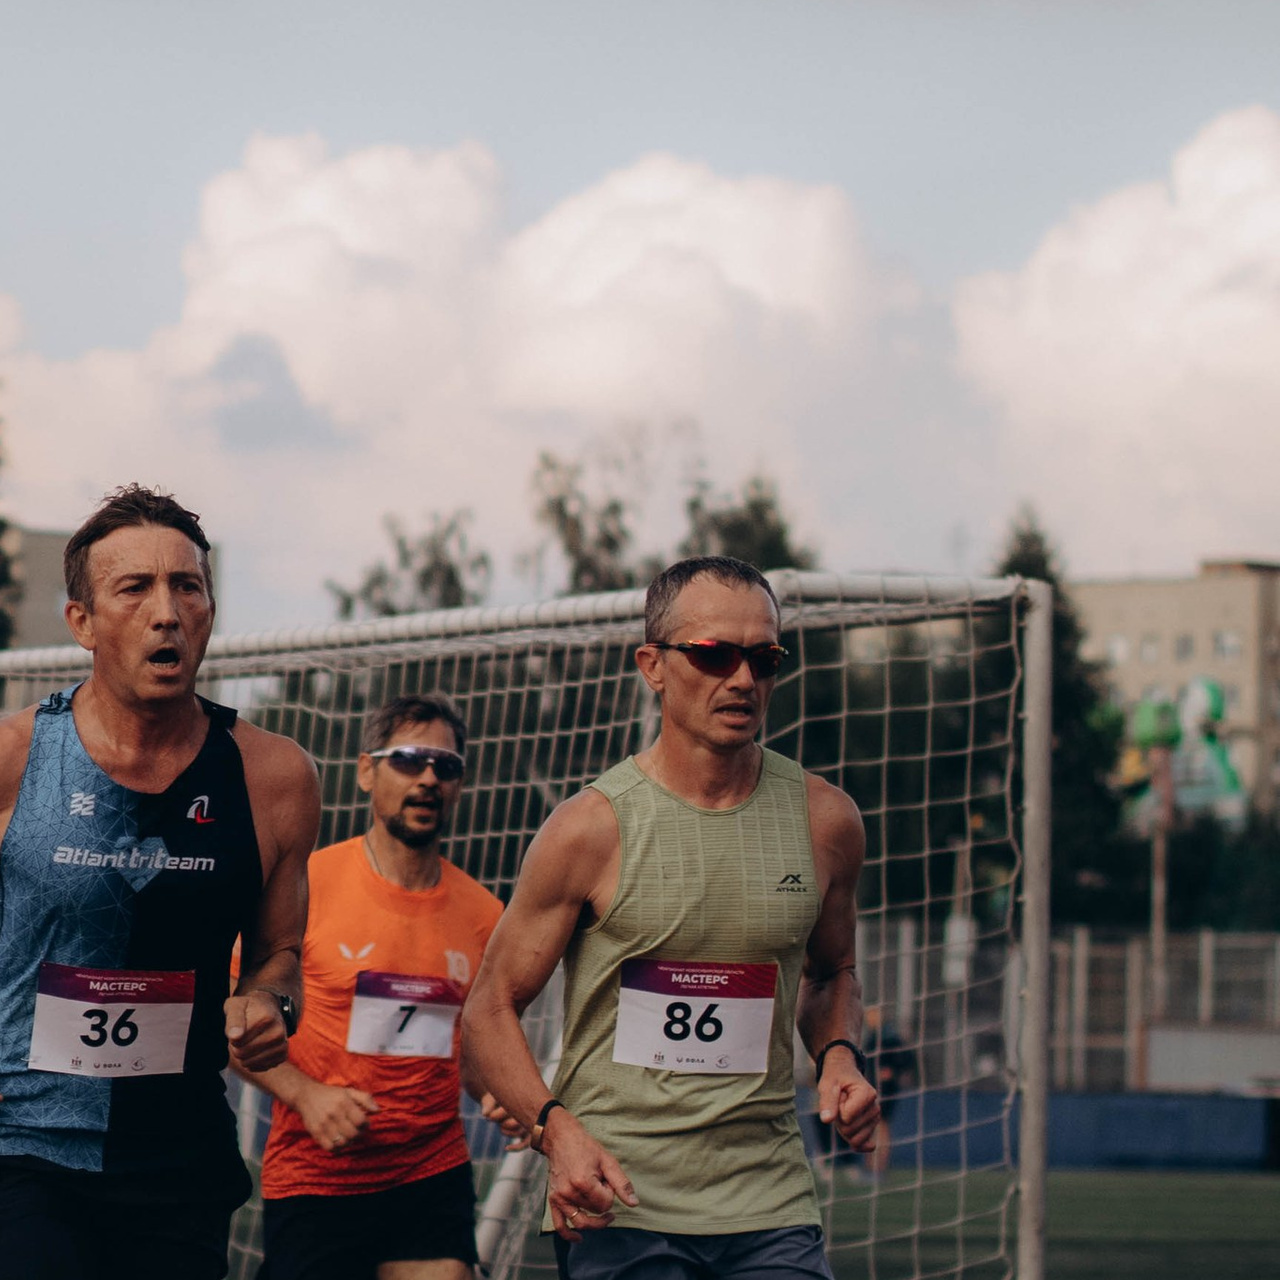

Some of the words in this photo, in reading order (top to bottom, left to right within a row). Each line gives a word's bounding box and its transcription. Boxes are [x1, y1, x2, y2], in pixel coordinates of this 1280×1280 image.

[89, 980, 148, 992] МАСТЕРС
[671, 973, 729, 985] МАСТЕРС
[80, 1008, 139, 1048] 36
[397, 1006, 417, 1033] 7
[663, 1001, 723, 1043] 86
